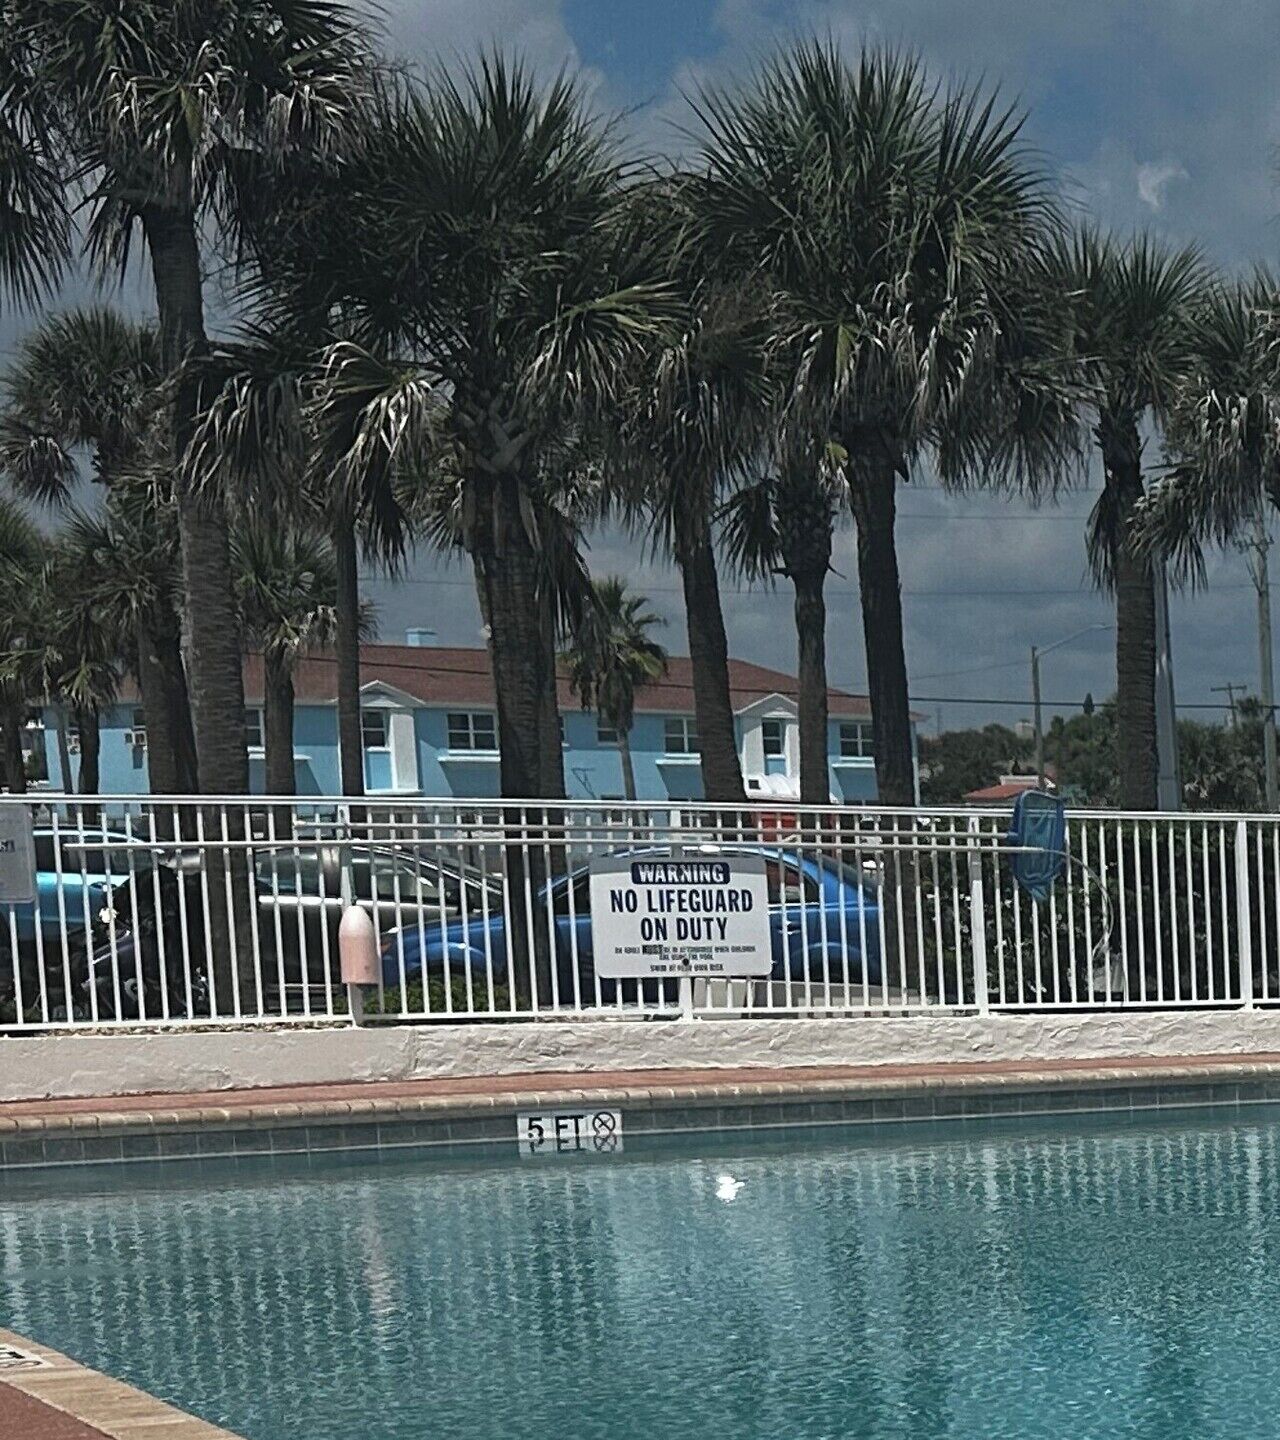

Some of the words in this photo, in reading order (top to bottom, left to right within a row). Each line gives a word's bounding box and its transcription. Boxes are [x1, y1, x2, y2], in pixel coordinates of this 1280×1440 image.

[638, 863, 725, 883] WARNING
[610, 889, 638, 913] NO
[647, 889, 754, 913] LIFEGUARD
[640, 917, 668, 941] ON
[676, 917, 728, 941] DUTY
[528, 1117, 544, 1140] 5
[555, 1115, 585, 1138] FT
